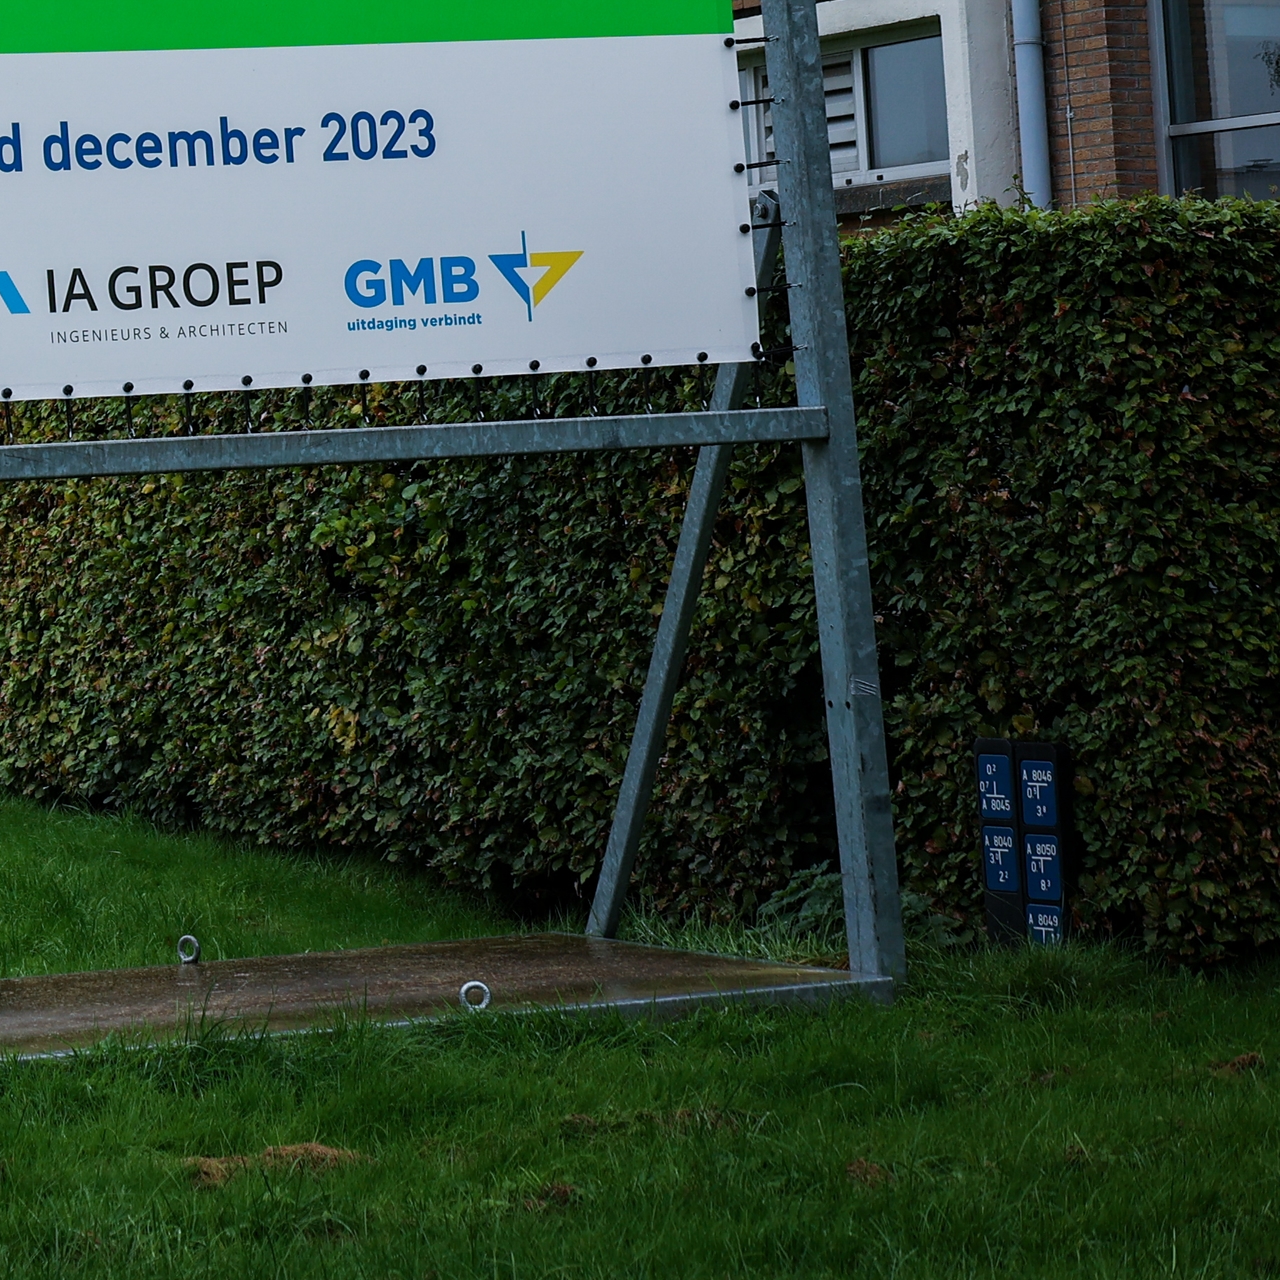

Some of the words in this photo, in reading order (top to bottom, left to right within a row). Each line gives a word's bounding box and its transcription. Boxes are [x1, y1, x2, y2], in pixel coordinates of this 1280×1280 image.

[42, 115, 307, 172] december
[320, 108, 437, 162] 2023
[46, 267, 99, 314] IA
[107, 260, 283, 311] GROEP
[343, 255, 480, 309] GMB
[346, 316, 417, 332] uitdaging
[420, 312, 483, 329] verbindt
[50, 326, 152, 344] INGENIEURS
[159, 326, 170, 340] &
[176, 320, 288, 339] ARCHITECTEN
[1022, 769, 1028, 780] A
[1032, 770, 1052, 782] 8046
[982, 799, 988, 810] A
[991, 799, 1011, 811] 8045
[984, 835, 990, 846] A
[993, 835, 1013, 847] 8040
[1026, 843, 1032, 855] A
[1036, 844, 1057, 856] 8050
[1028, 913, 1034, 925] A
[1038, 914, 1058, 927] 8049
